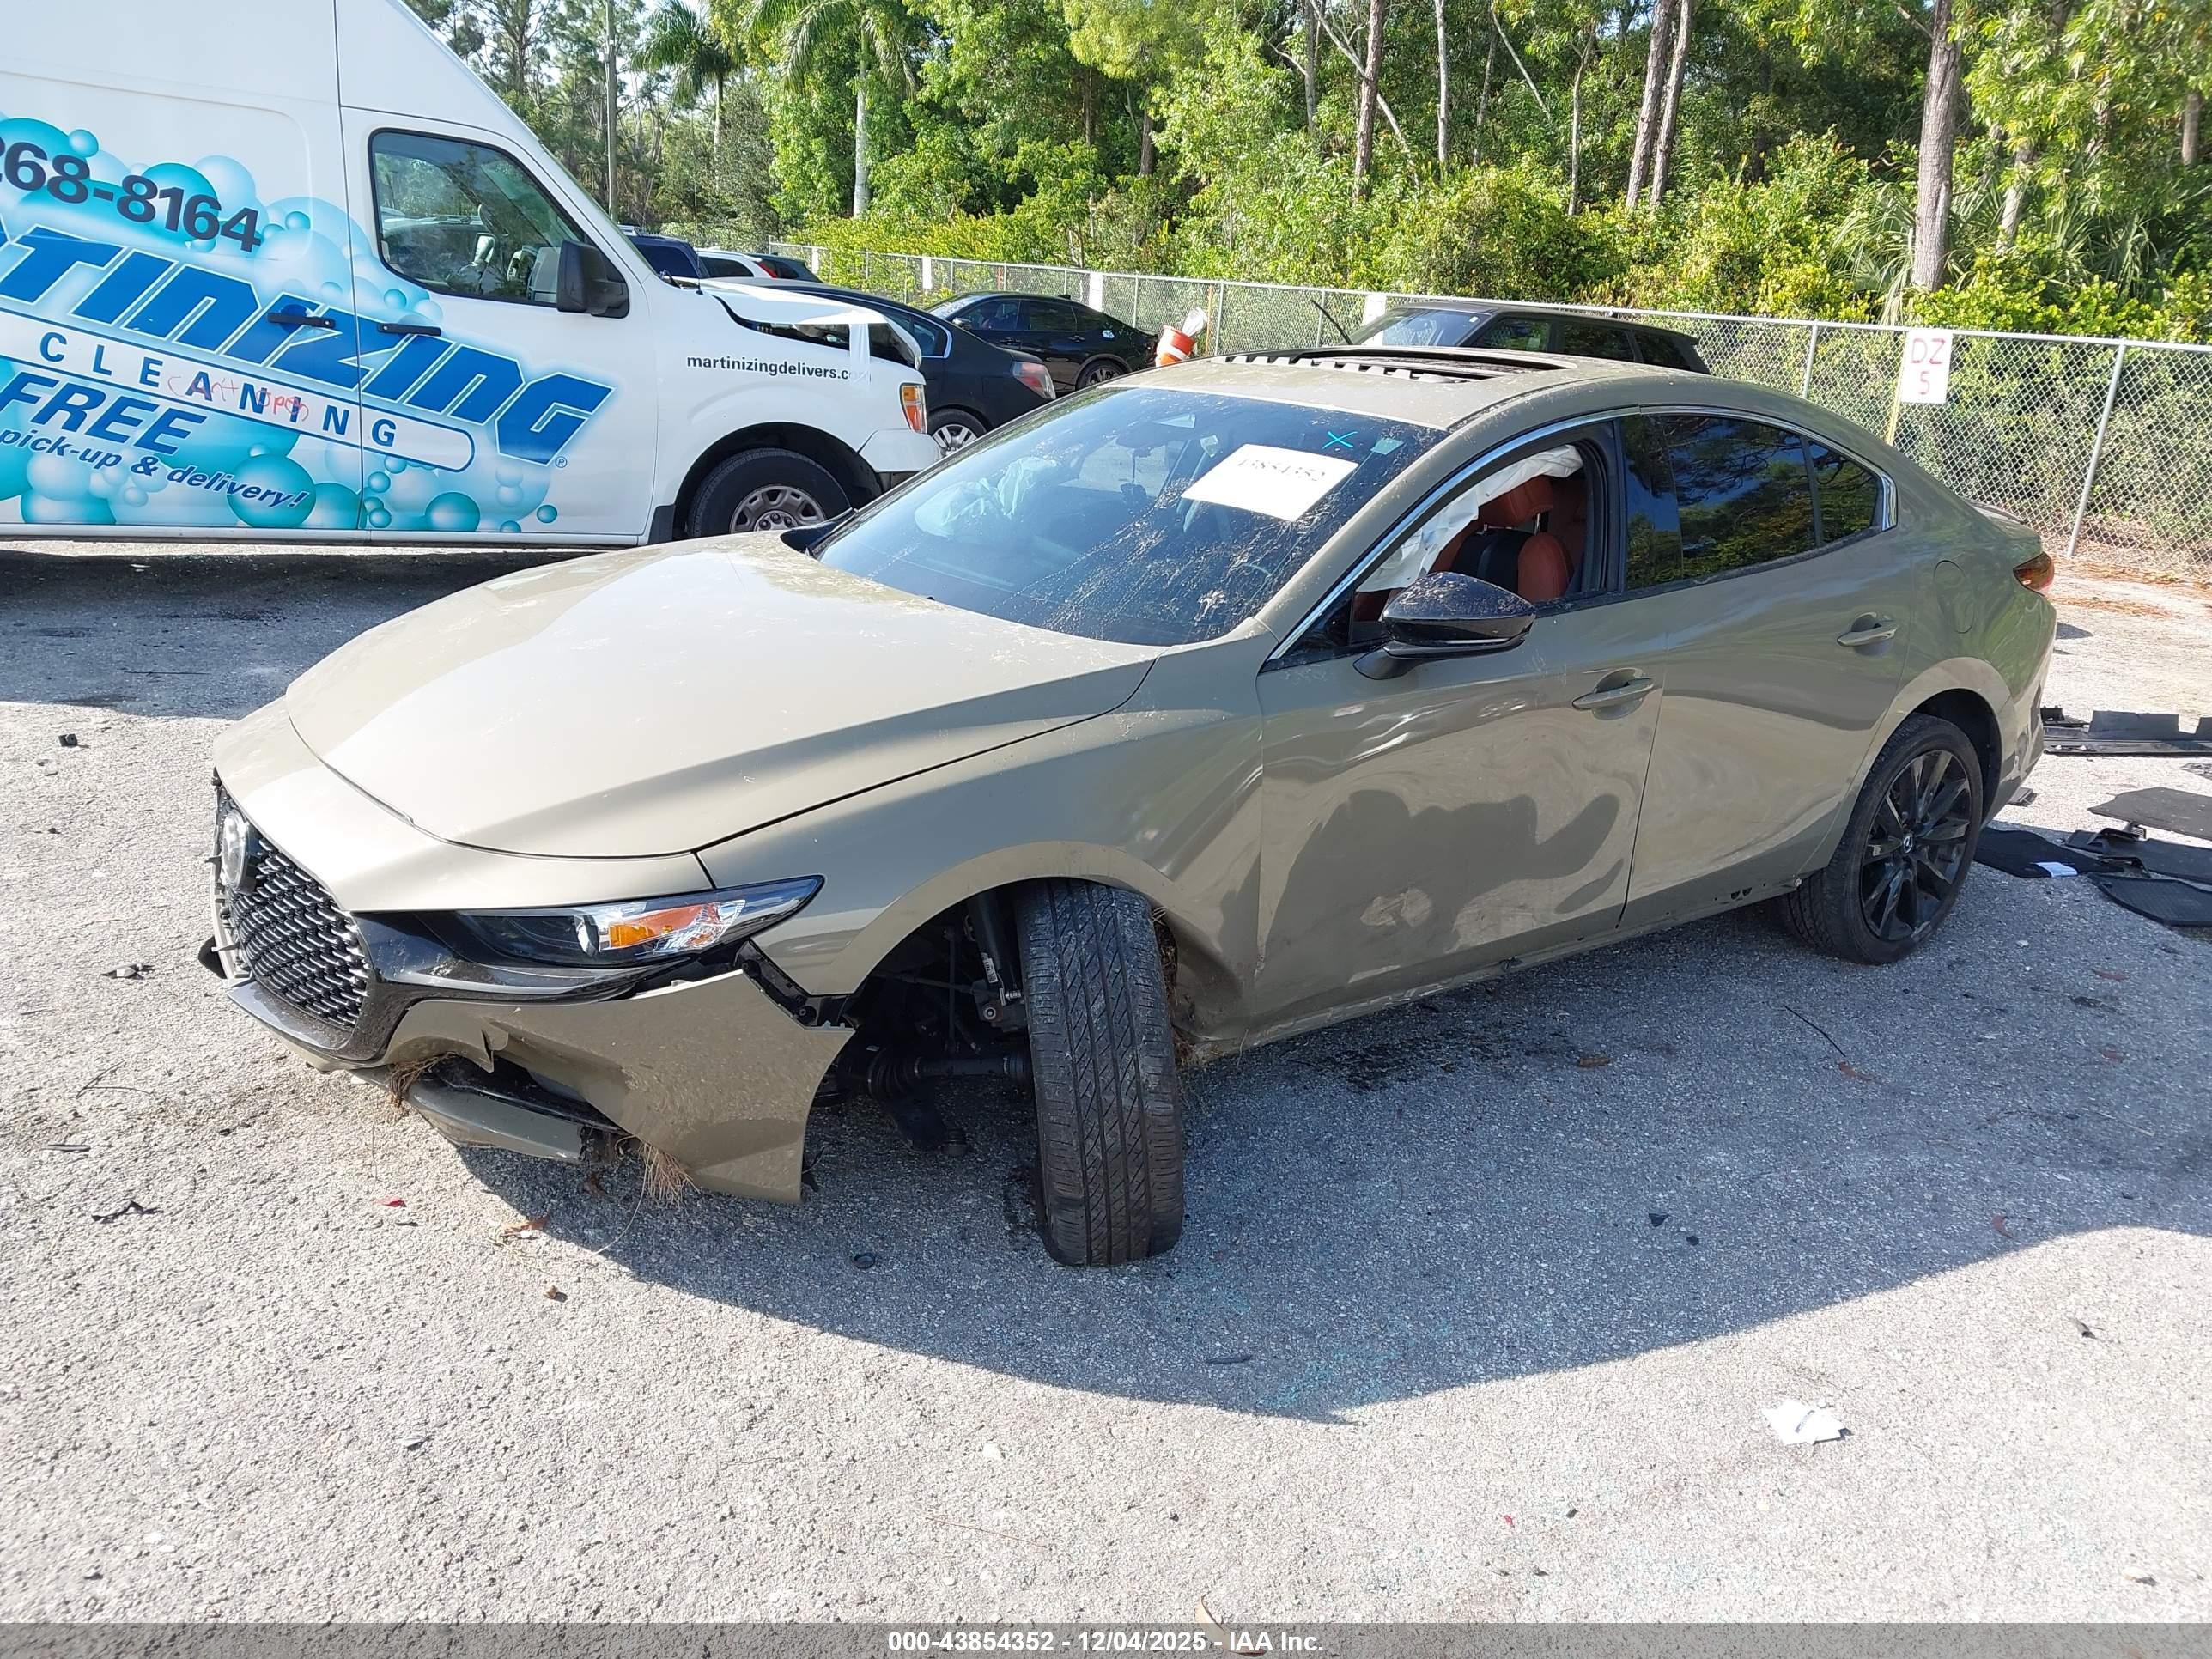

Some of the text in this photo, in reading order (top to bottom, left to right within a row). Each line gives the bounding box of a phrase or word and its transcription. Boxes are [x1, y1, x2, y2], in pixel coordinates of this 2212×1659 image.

[686, 355, 872, 384] martinizingdelivers.c
[0, 371, 208, 455] FREE
[0, 429, 307, 508] pick-up & delivery!
